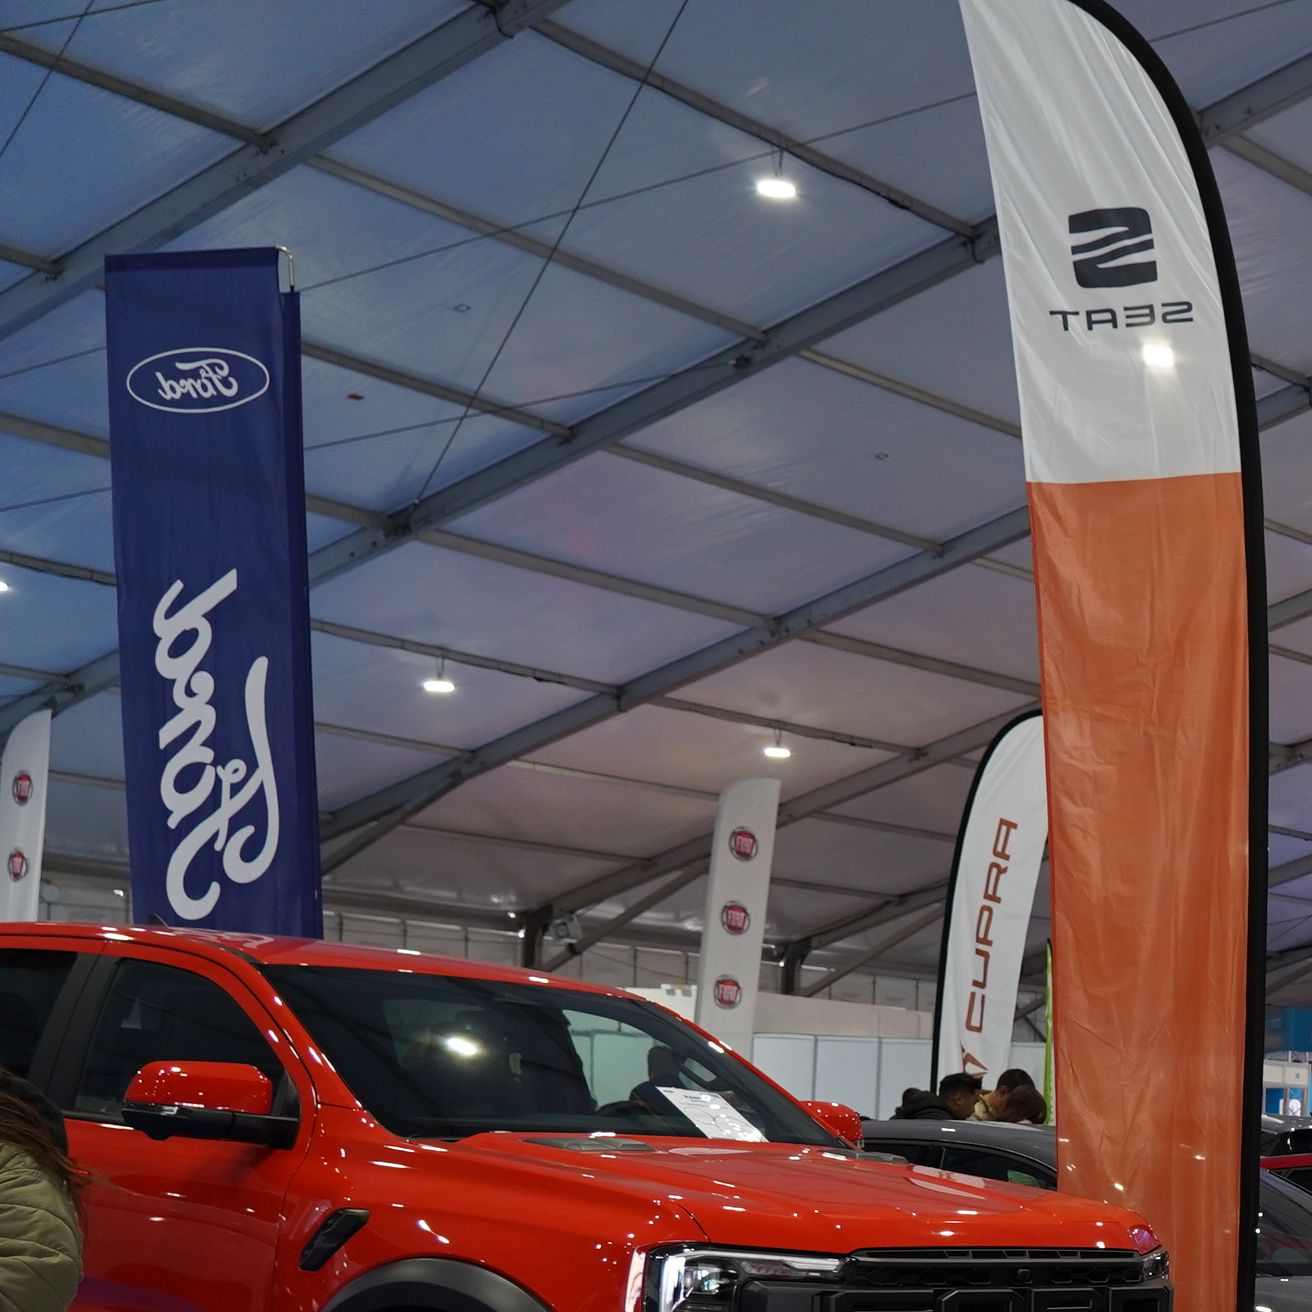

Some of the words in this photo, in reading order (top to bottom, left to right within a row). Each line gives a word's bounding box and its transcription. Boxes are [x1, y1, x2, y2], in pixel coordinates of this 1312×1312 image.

[734, 835, 755, 853] FIAT
[726, 911, 746, 929] FIAT
[964, 817, 1018, 1034] CUPRA
[717, 985, 738, 1002] FIAT
